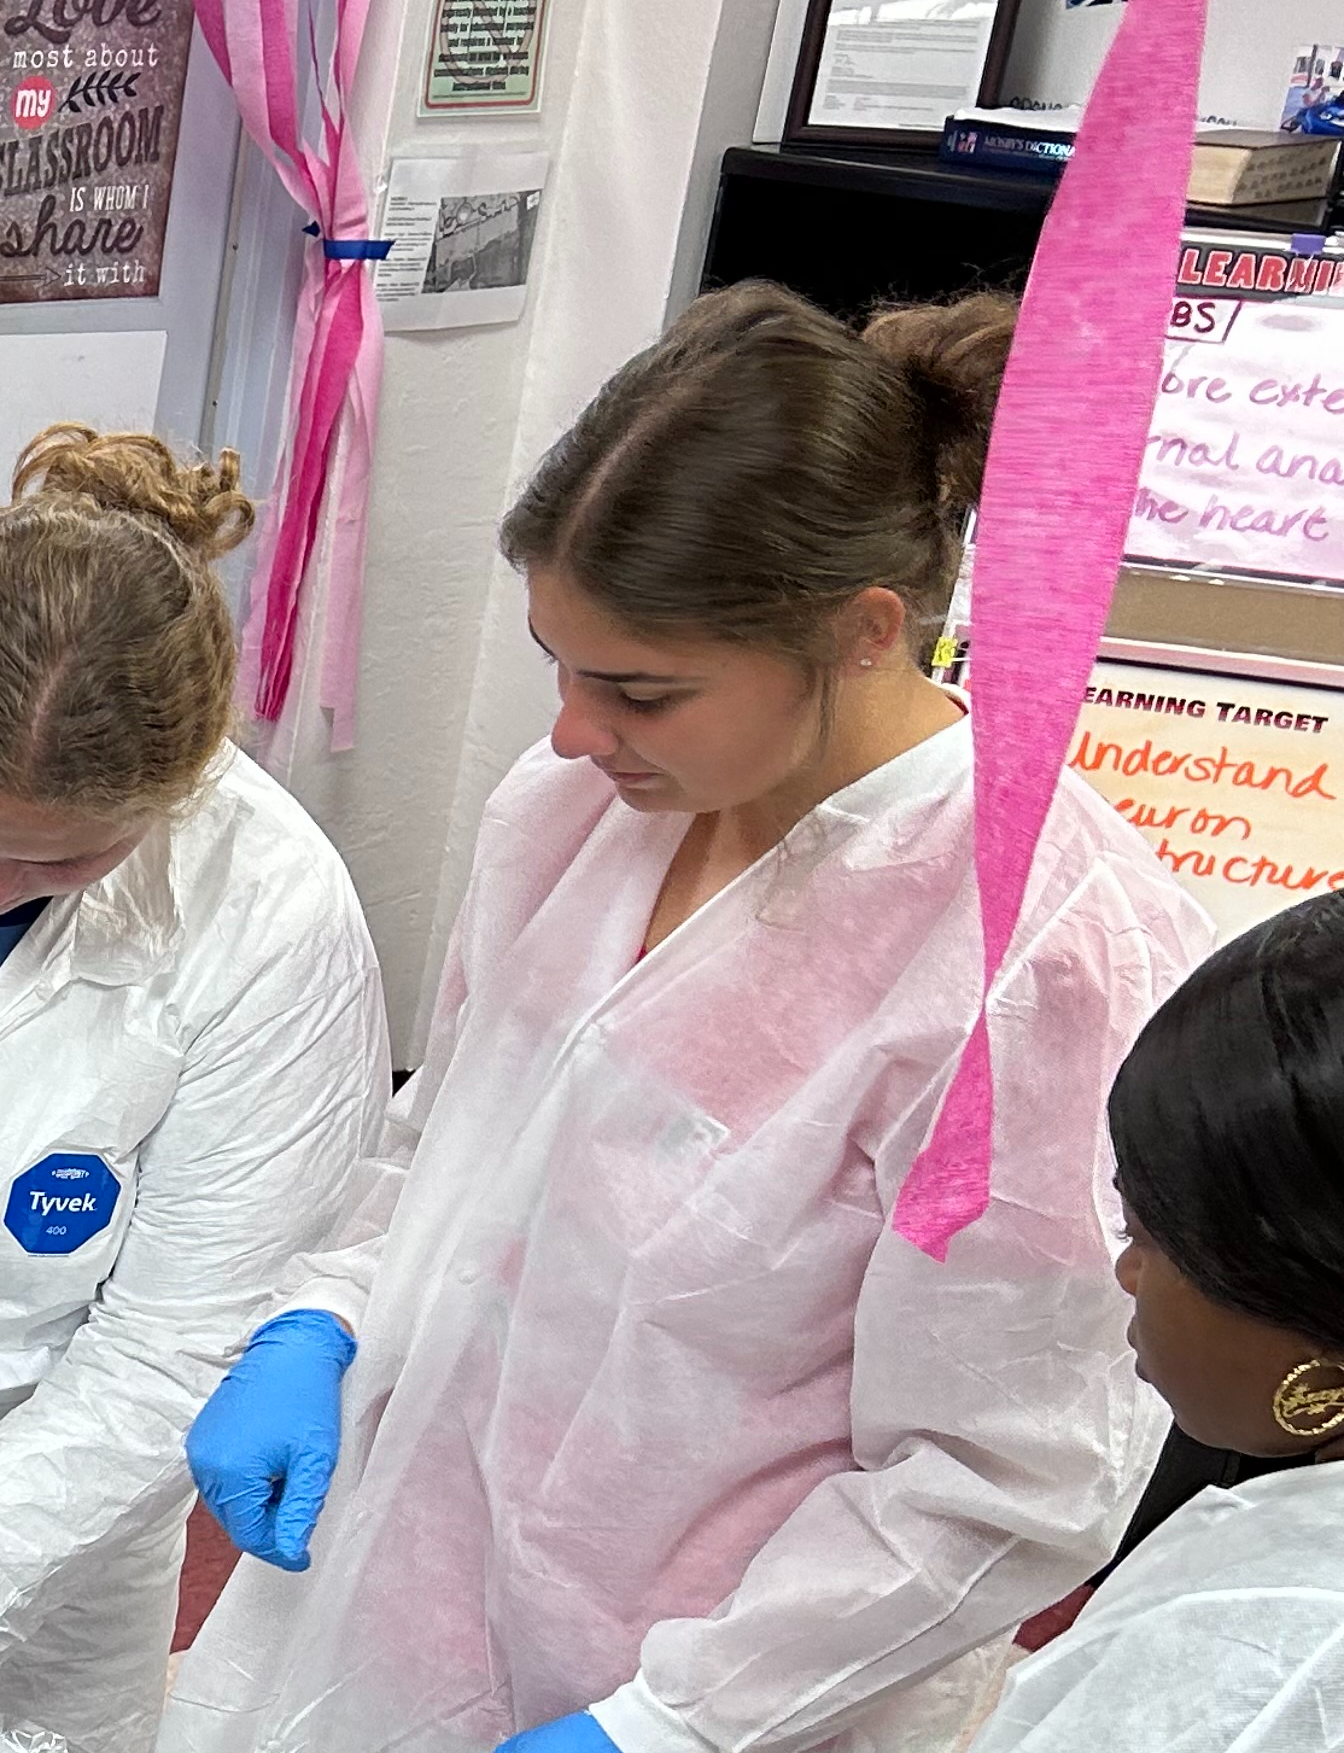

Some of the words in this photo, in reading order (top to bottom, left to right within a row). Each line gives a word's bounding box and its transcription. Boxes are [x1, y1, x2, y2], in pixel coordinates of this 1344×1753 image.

[13, 44, 74, 68] most
[85, 42, 158, 67] about
[15, 86, 52, 118] my
[69, 186, 86, 212] IS
[93, 185, 136, 211] WHOM
[142, 184, 150, 210] I
[0, 194, 145, 258] share
[63, 263, 86, 286] it
[95, 259, 146, 285] with
[1170, 301, 1216, 333] BS
[1162, 372, 1232, 404] ore
[1249, 373, 1344, 415] exte
[1256, 445, 1344, 486] ana
[1134, 486, 1189, 524] he
[1198, 493, 1330, 541] heart
[1083, 686, 1206, 718] EARNING
[1217, 701, 1329, 733] TARGET
[1114, 797, 1252, 840] euron
[1154, 838, 1344, 893] tructure
[29, 1190, 98, 1216] Tyvek
[45, 1225, 67, 1236] 400
